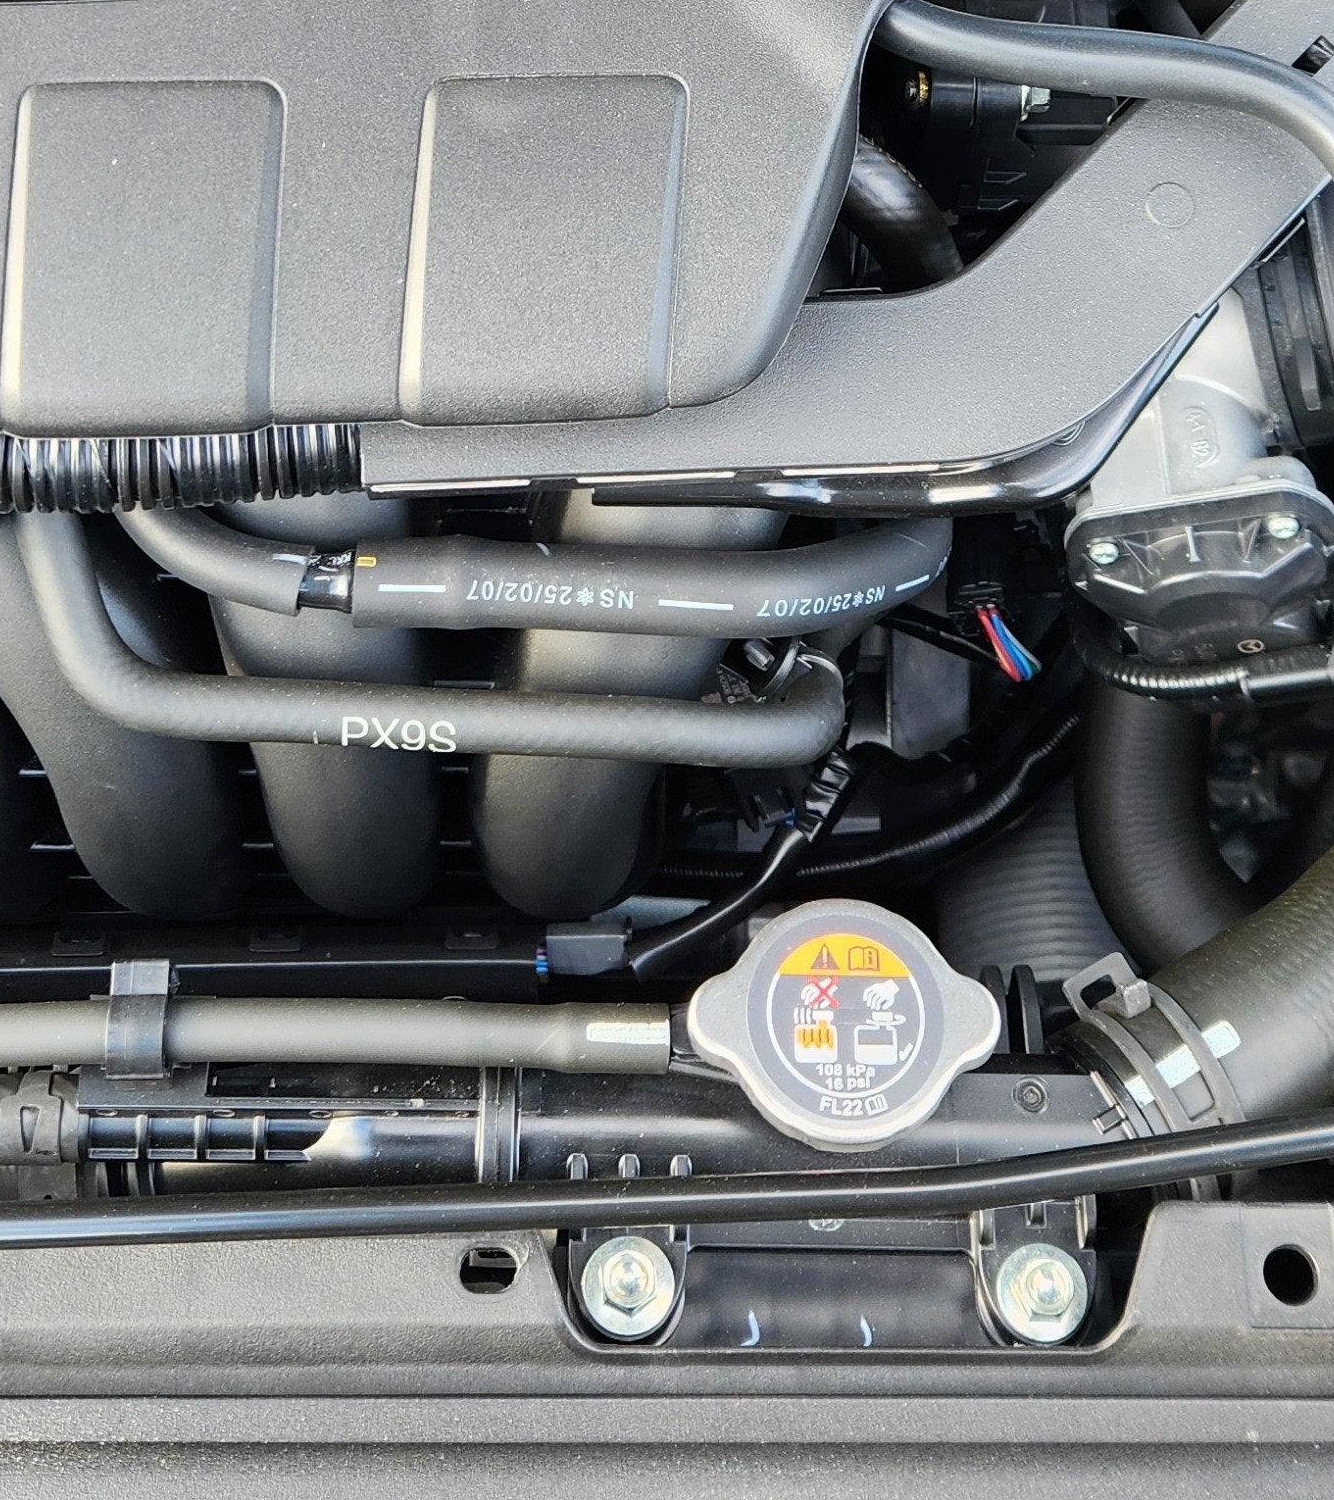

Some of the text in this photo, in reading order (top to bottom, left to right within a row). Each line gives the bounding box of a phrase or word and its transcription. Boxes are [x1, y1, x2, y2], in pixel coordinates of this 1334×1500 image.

[341, 716, 457, 753] PX9S
[816, 1063, 843, 1077] 108
[819, 1095, 864, 1117] FL22
